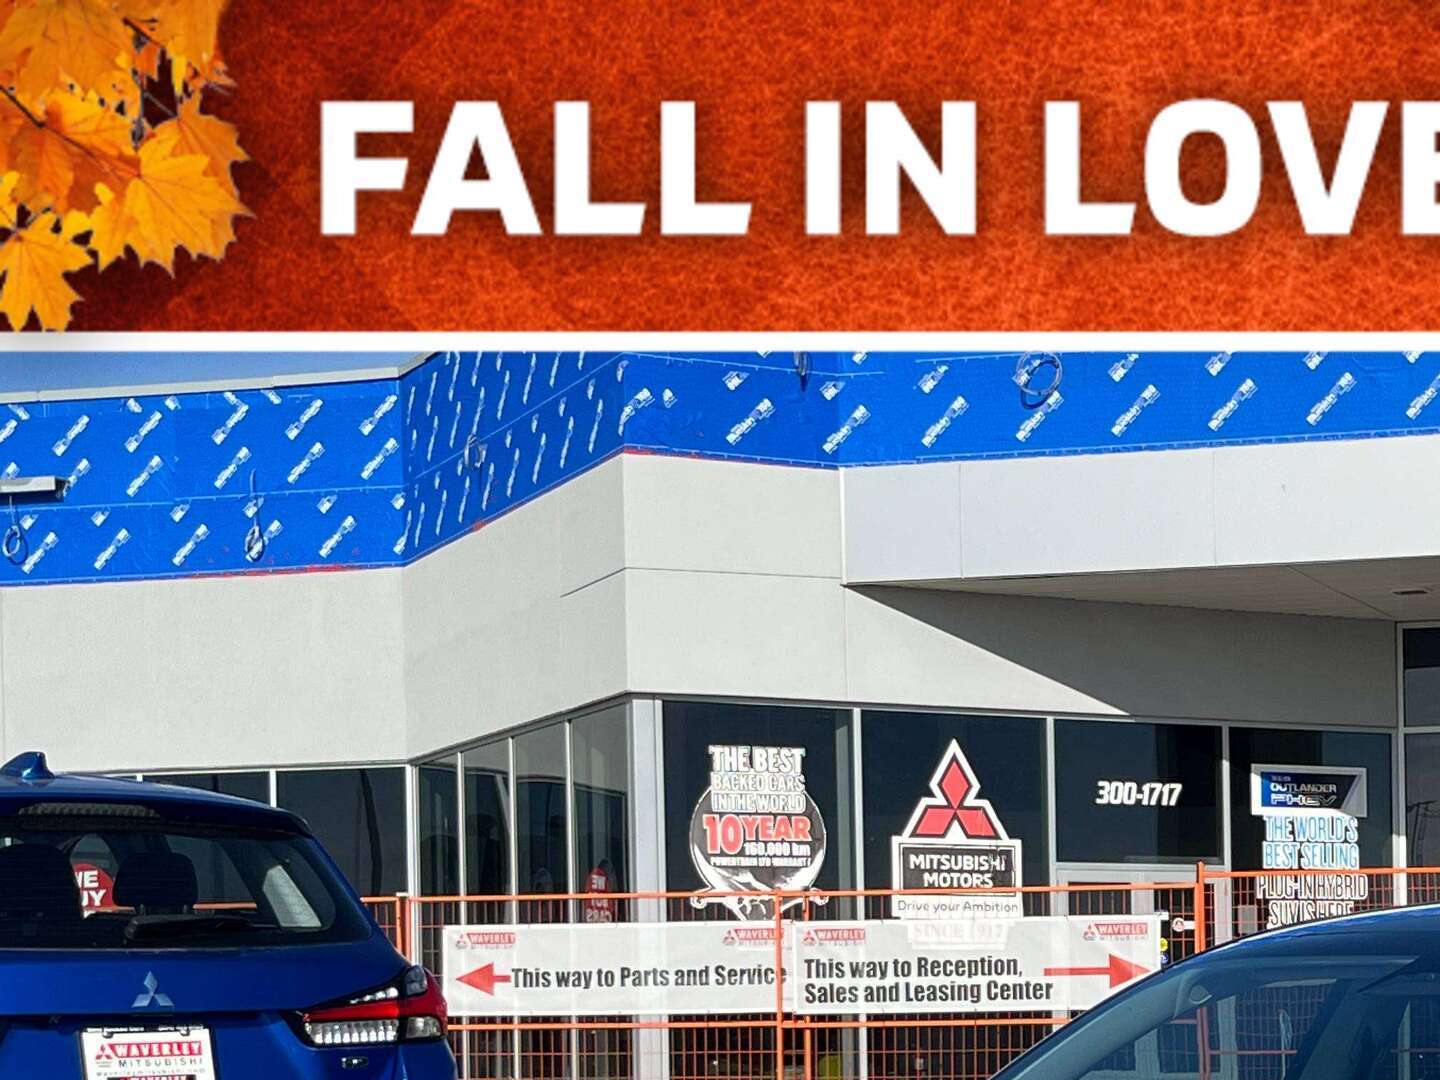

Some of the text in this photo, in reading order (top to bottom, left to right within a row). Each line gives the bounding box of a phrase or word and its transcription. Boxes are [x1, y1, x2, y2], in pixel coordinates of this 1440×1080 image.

[709, 745, 806, 774] THE BEST
[712, 773, 805, 792] BACKED CARS
[1270, 783, 1337, 793] OUTLANDER
[1095, 780, 1182, 806] 300-1717
[756, 794, 806, 813] WORLD
[703, 814, 812, 854] 10 YEAR
[1263, 815, 1358, 842] THE WORLD'S
[909, 854, 1006, 871] MITSUBISHI
[1263, 841, 1360, 870] BEST SELLING
[923, 872, 994, 888] MOTORS
[1315, 874, 1369, 900] HYBRID
[897, 900, 1018, 913] Drive your Ambition
[816, 929, 865, 940] WAVERLEY
[1097, 923, 1147, 935] WAVERLEY
[512, 964, 787, 990] This way to Parts and Service
[804, 956, 1023, 982] This way to Reception,
[804, 980, 1053, 1004] Sales and Leasing Center
[114, 1042, 202, 1057] WAVERLEY
[119, 1058, 203, 1067] MITSUBISHI
